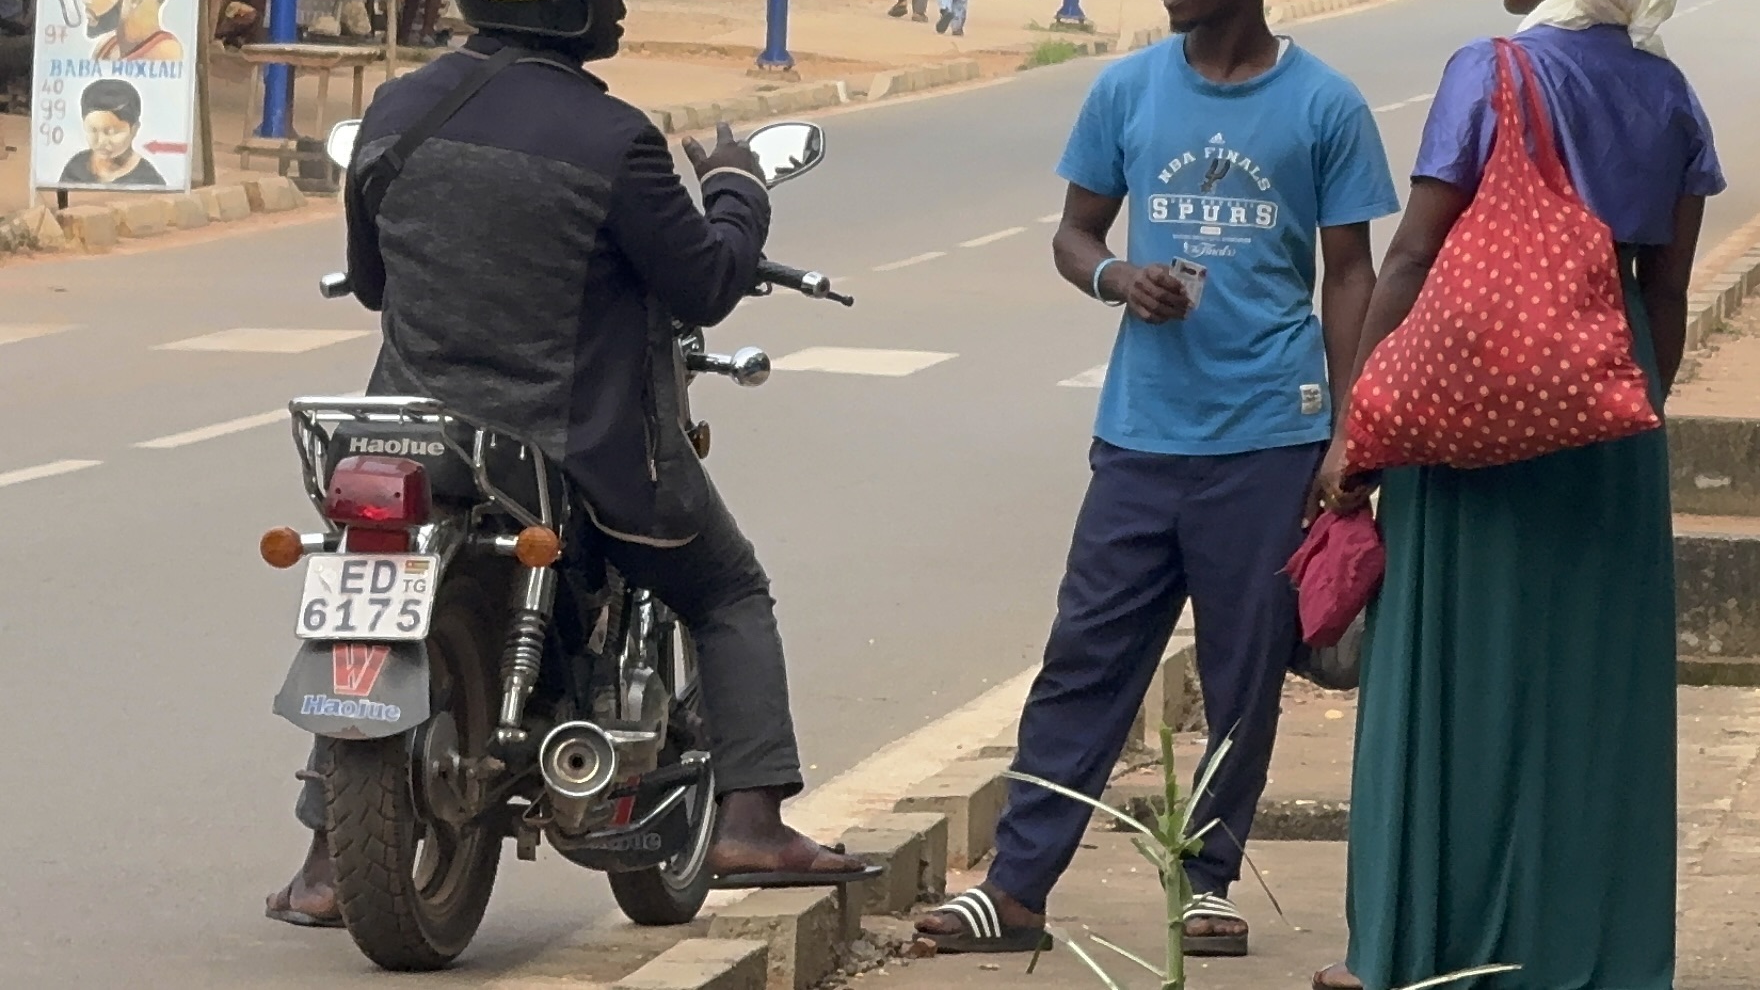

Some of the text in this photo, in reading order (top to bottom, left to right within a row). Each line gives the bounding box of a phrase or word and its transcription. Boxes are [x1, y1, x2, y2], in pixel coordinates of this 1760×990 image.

[50, 59, 103, 77] BABA
[41, 79, 64, 95] 40
[1158, 147, 1271, 191] NBA FINALS
[1152, 197, 1273, 225] SPURS
[340, 559, 397, 595] ED
[403, 578, 427, 594] TG
[303, 597, 421, 633] 6175
